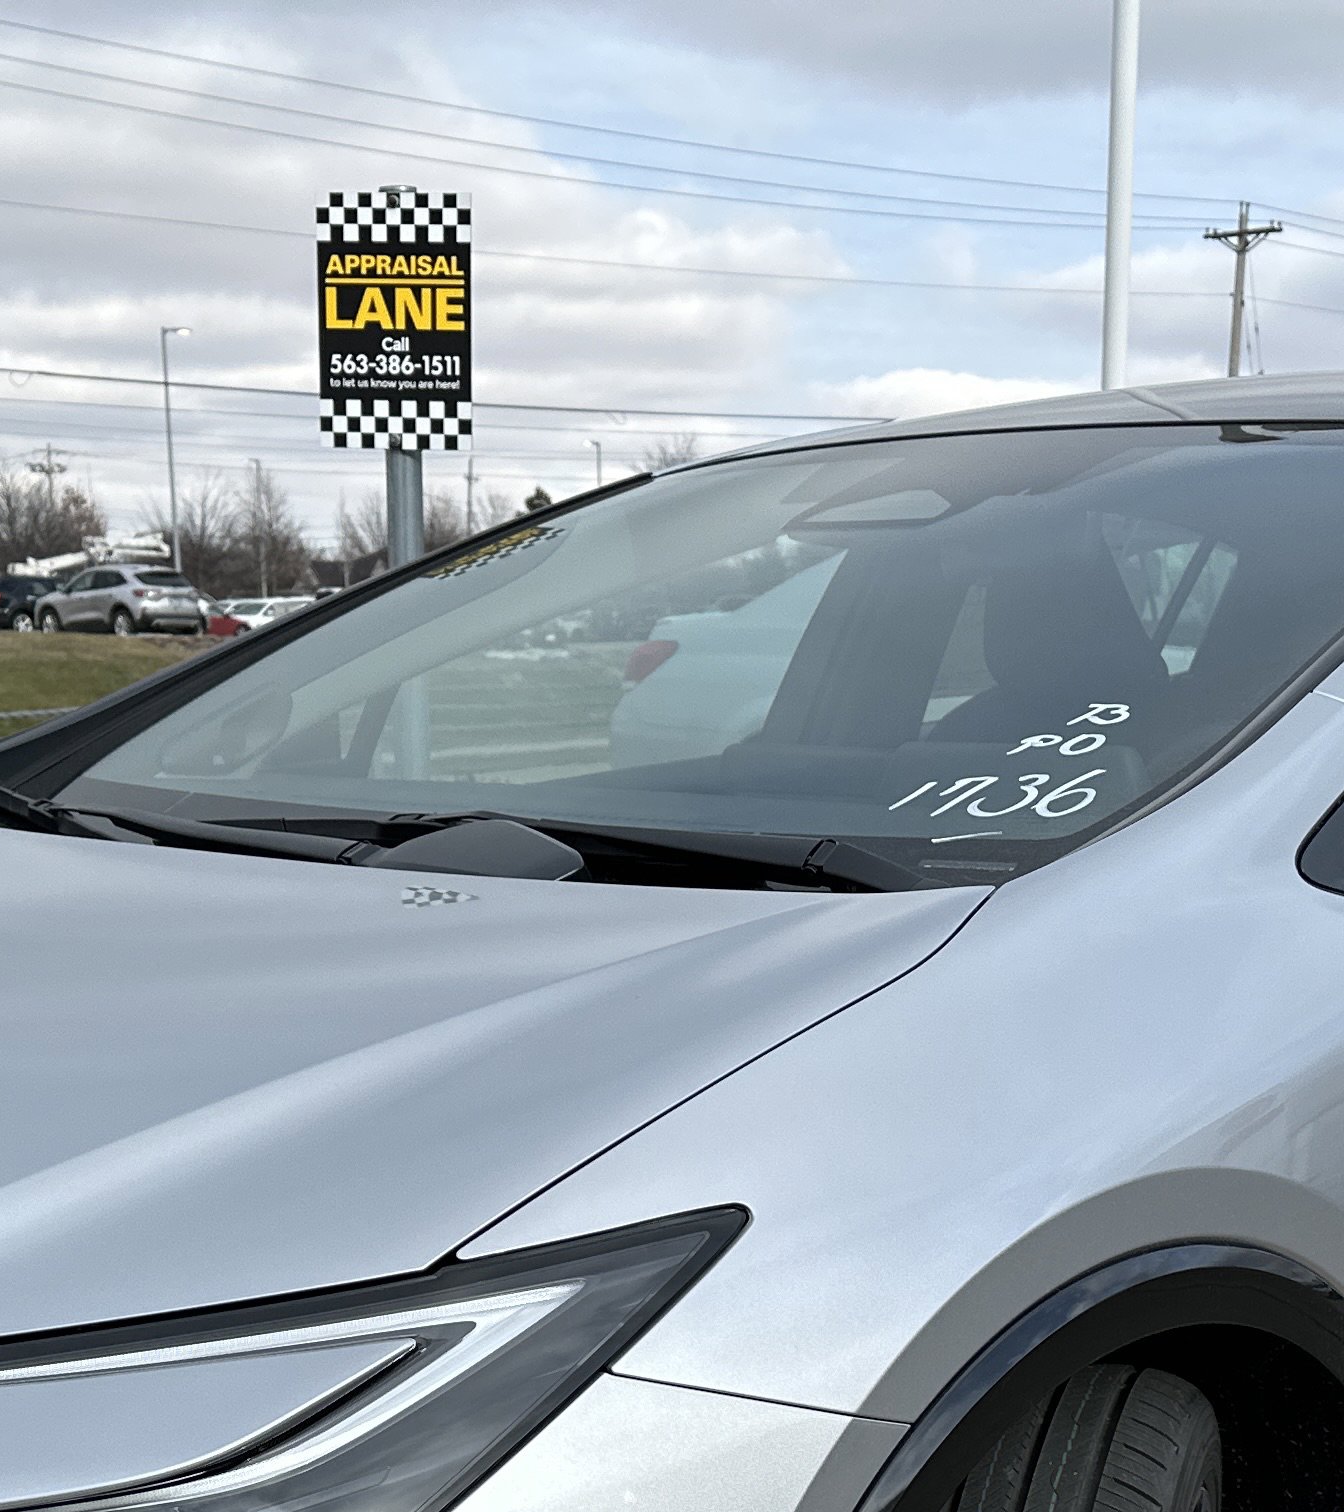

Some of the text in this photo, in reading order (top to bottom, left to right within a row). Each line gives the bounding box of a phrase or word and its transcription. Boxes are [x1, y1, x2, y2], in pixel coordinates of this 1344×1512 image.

[325, 254, 465, 276] APPRAISAL
[325, 286, 465, 331] LANE
[381, 336, 410, 352] Call
[329, 353, 461, 376] 563-386-1511
[329, 377, 341, 387] to
[342, 377, 356, 388] let
[357, 380, 370, 388] us
[370, 378, 397, 388] know
[397, 380, 417, 390] you
[417, 380, 435, 389] are
